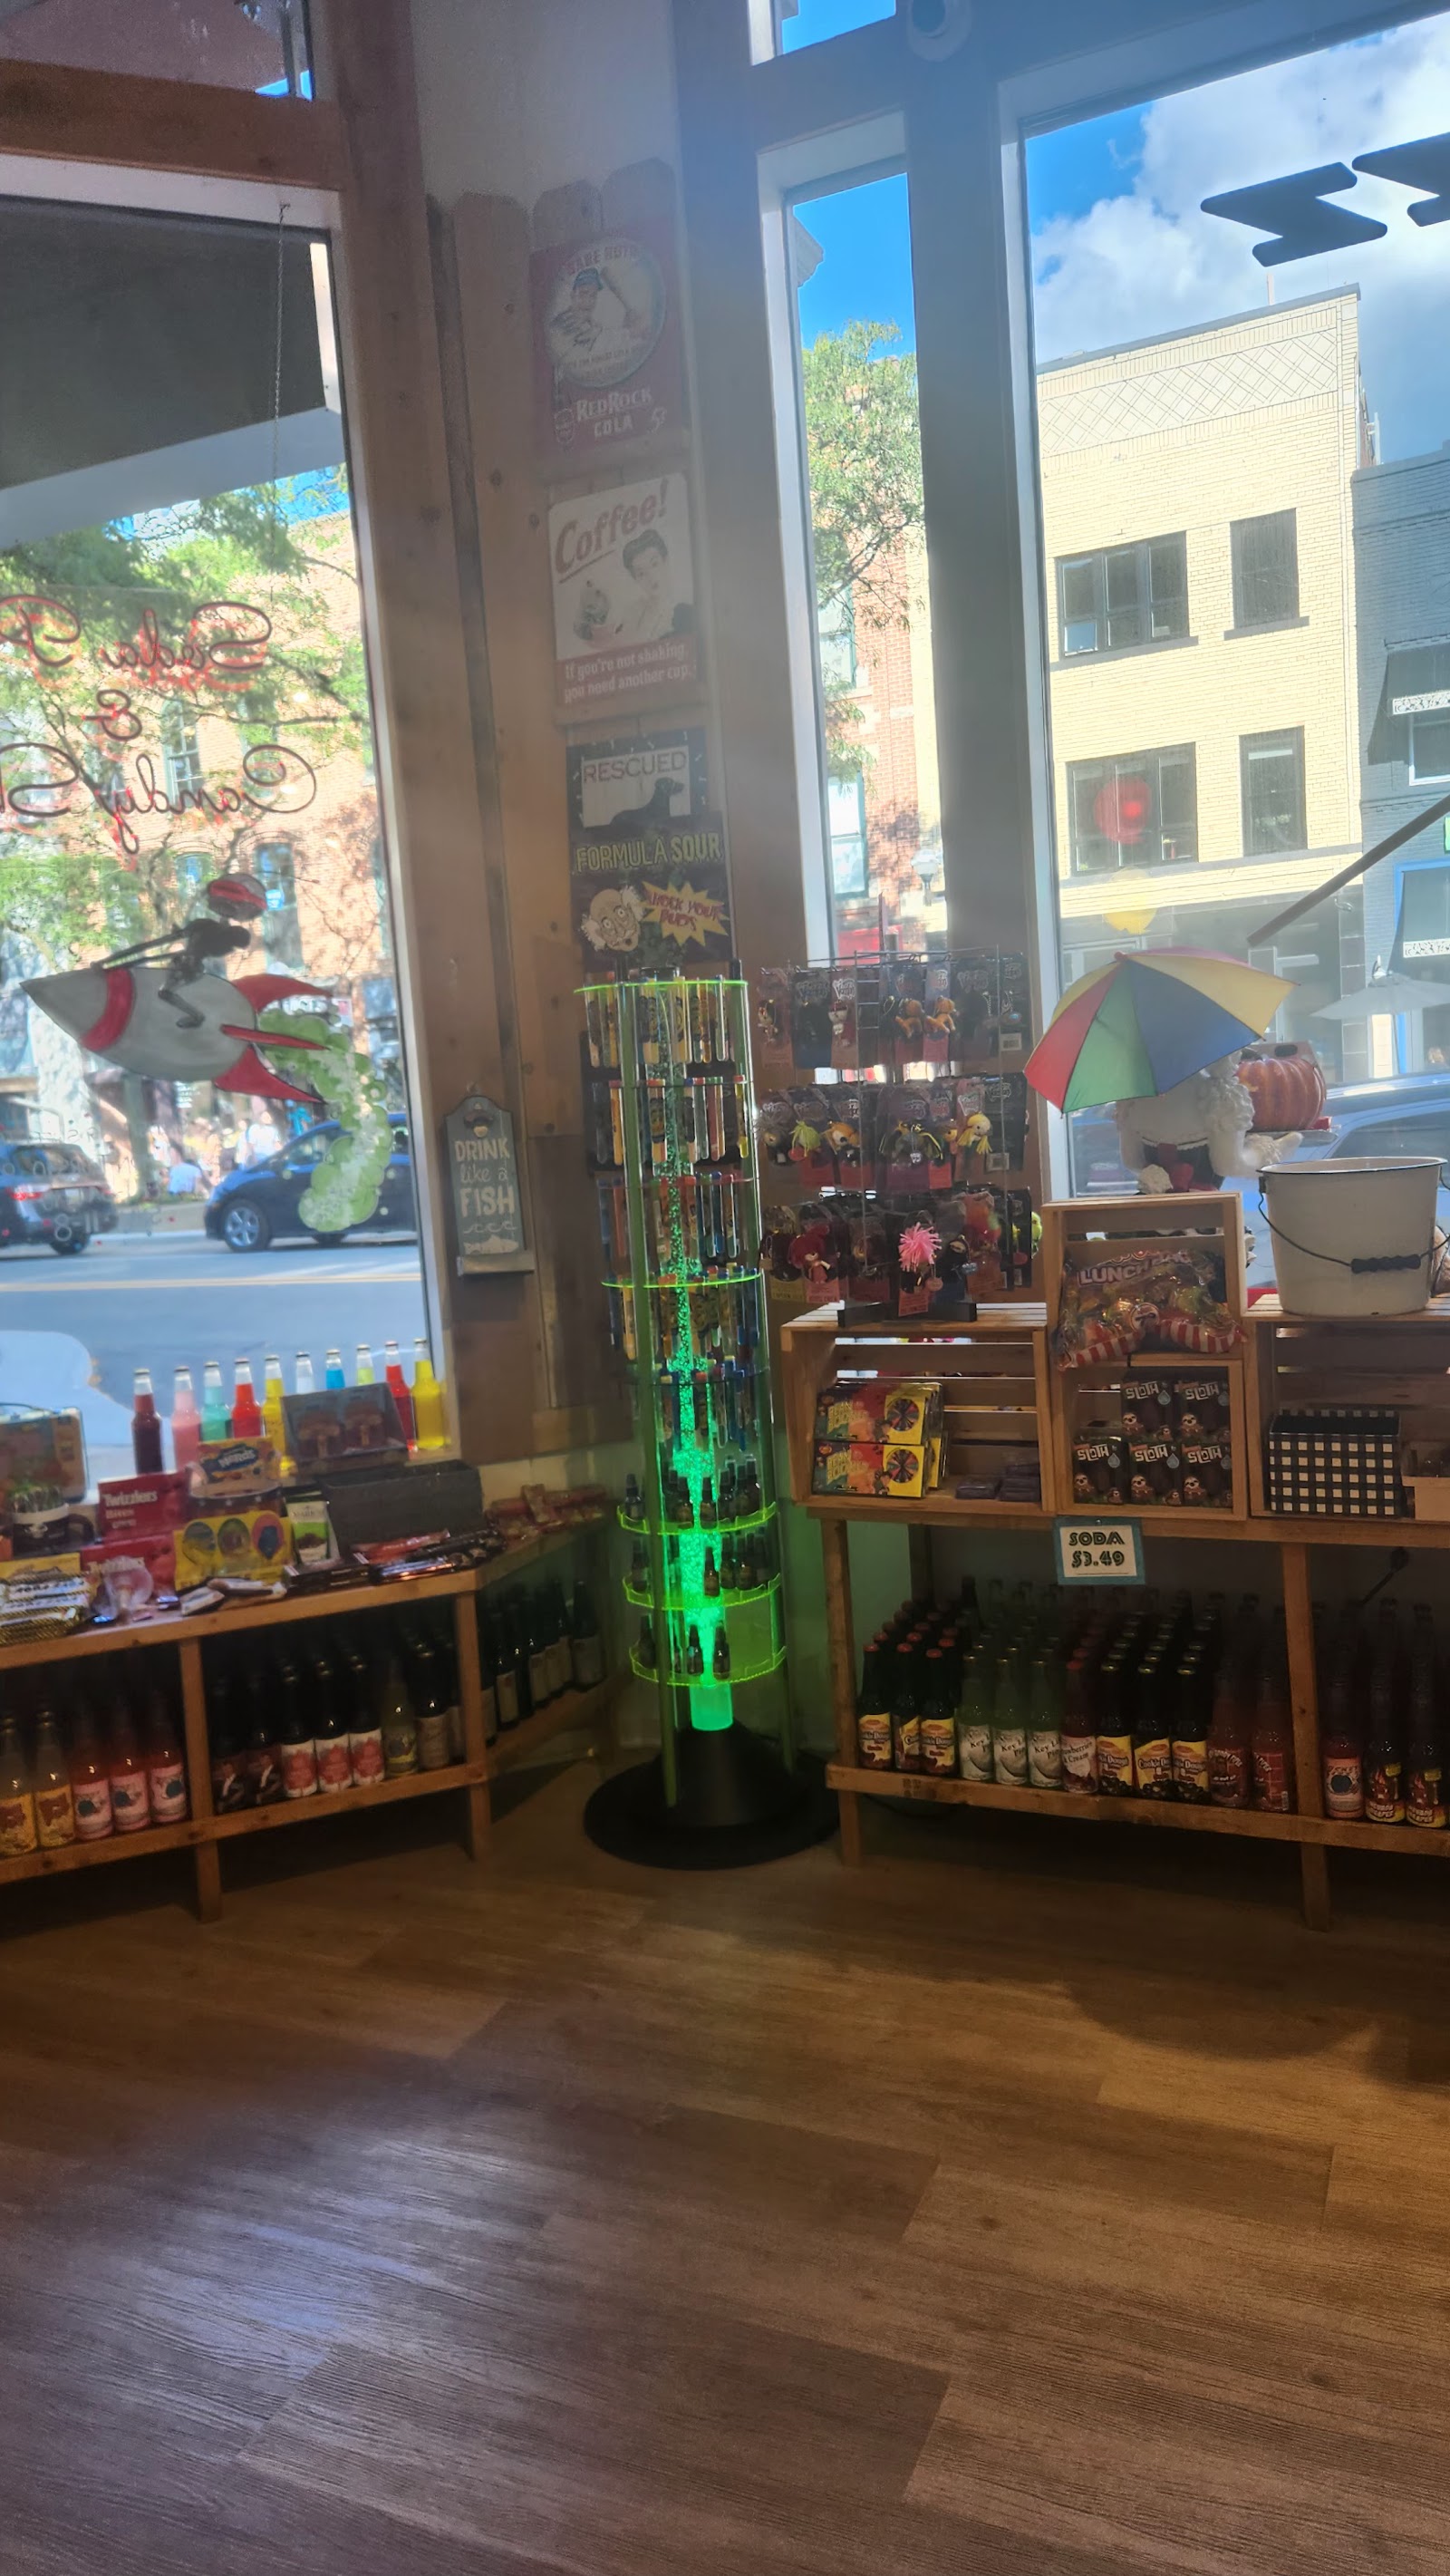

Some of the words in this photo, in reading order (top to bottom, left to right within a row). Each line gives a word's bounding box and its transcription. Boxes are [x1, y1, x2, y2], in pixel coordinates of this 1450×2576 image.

[594, 414, 634, 438] COLA
[555, 477, 669, 574] Coffee!
[565, 662, 576, 679] If
[577, 658, 614, 681] you're
[616, 654, 636, 668] not
[564, 685, 585, 703] you
[587, 675, 616, 694] need
[618, 668, 666, 690] another
[583, 750, 687, 784] RESCUED
[575, 836, 669, 872] FORMULA
[671, 831, 722, 863] SOUR
[455, 1137, 510, 1162] DRINK
[460, 1164, 491, 1184] like
[498, 1167, 508, 1182] a
[460, 1186, 516, 1217] FISH
[1126, 1380, 1159, 1399] SLOTH
[1185, 1381, 1219, 1400] SLOTH
[1078, 1444, 1109, 1461] SLOTH
[1135, 1444, 1168, 1463] SLOTH
[1187, 1445, 1223, 1464] SLOTH
[1068, 1531, 1125, 1546] SODA
[1071, 1550, 1125, 1568] $3.49
[971, 1739, 984, 1748] Key
[1001, 1744, 1015, 1752] Key
[1138, 1758, 1160, 1769] Cookie
